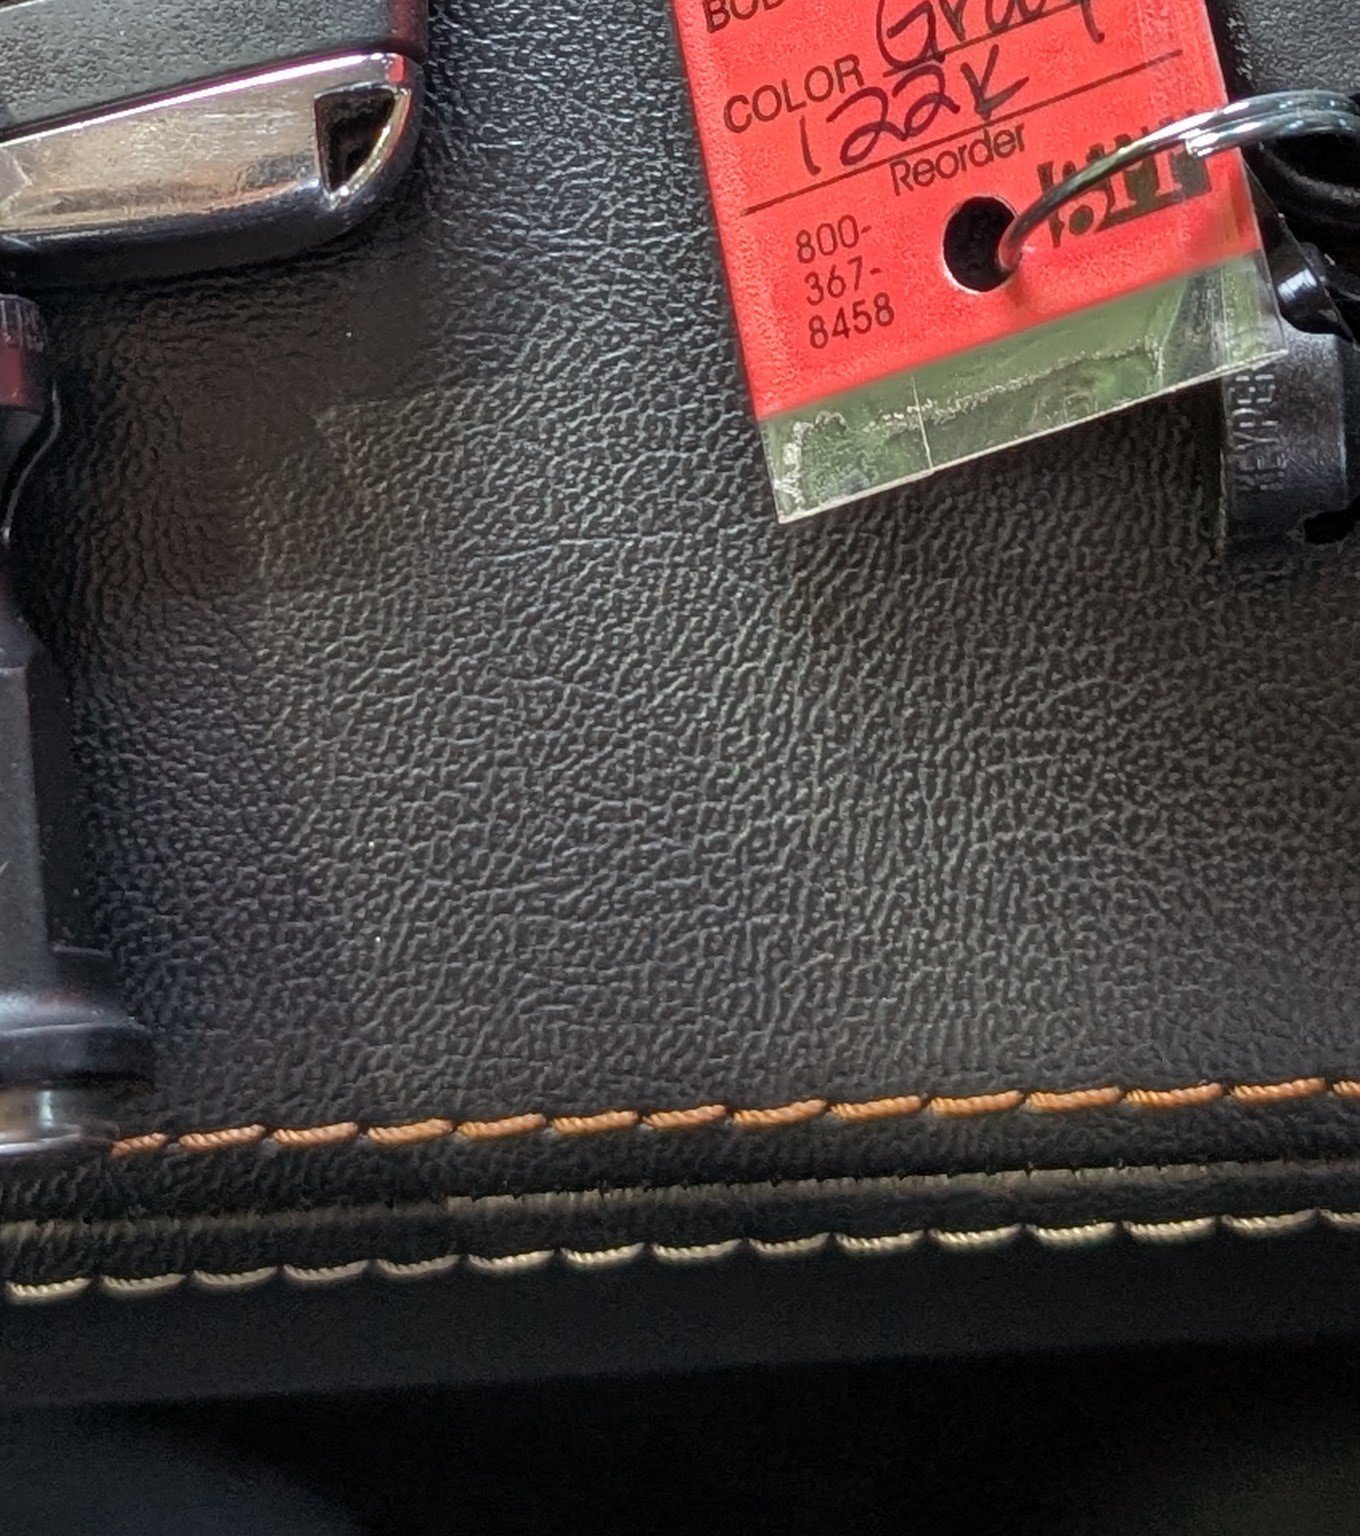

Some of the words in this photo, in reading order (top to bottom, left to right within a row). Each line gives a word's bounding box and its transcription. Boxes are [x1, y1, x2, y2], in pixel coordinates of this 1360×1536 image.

[722, 59, 864, 134] COLOR
[890, 124, 1027, 198] Reorder
[795, 213, 872, 265] 800-
[803, 264, 882, 309] 367-
[808, 301, 896, 351] 8458
